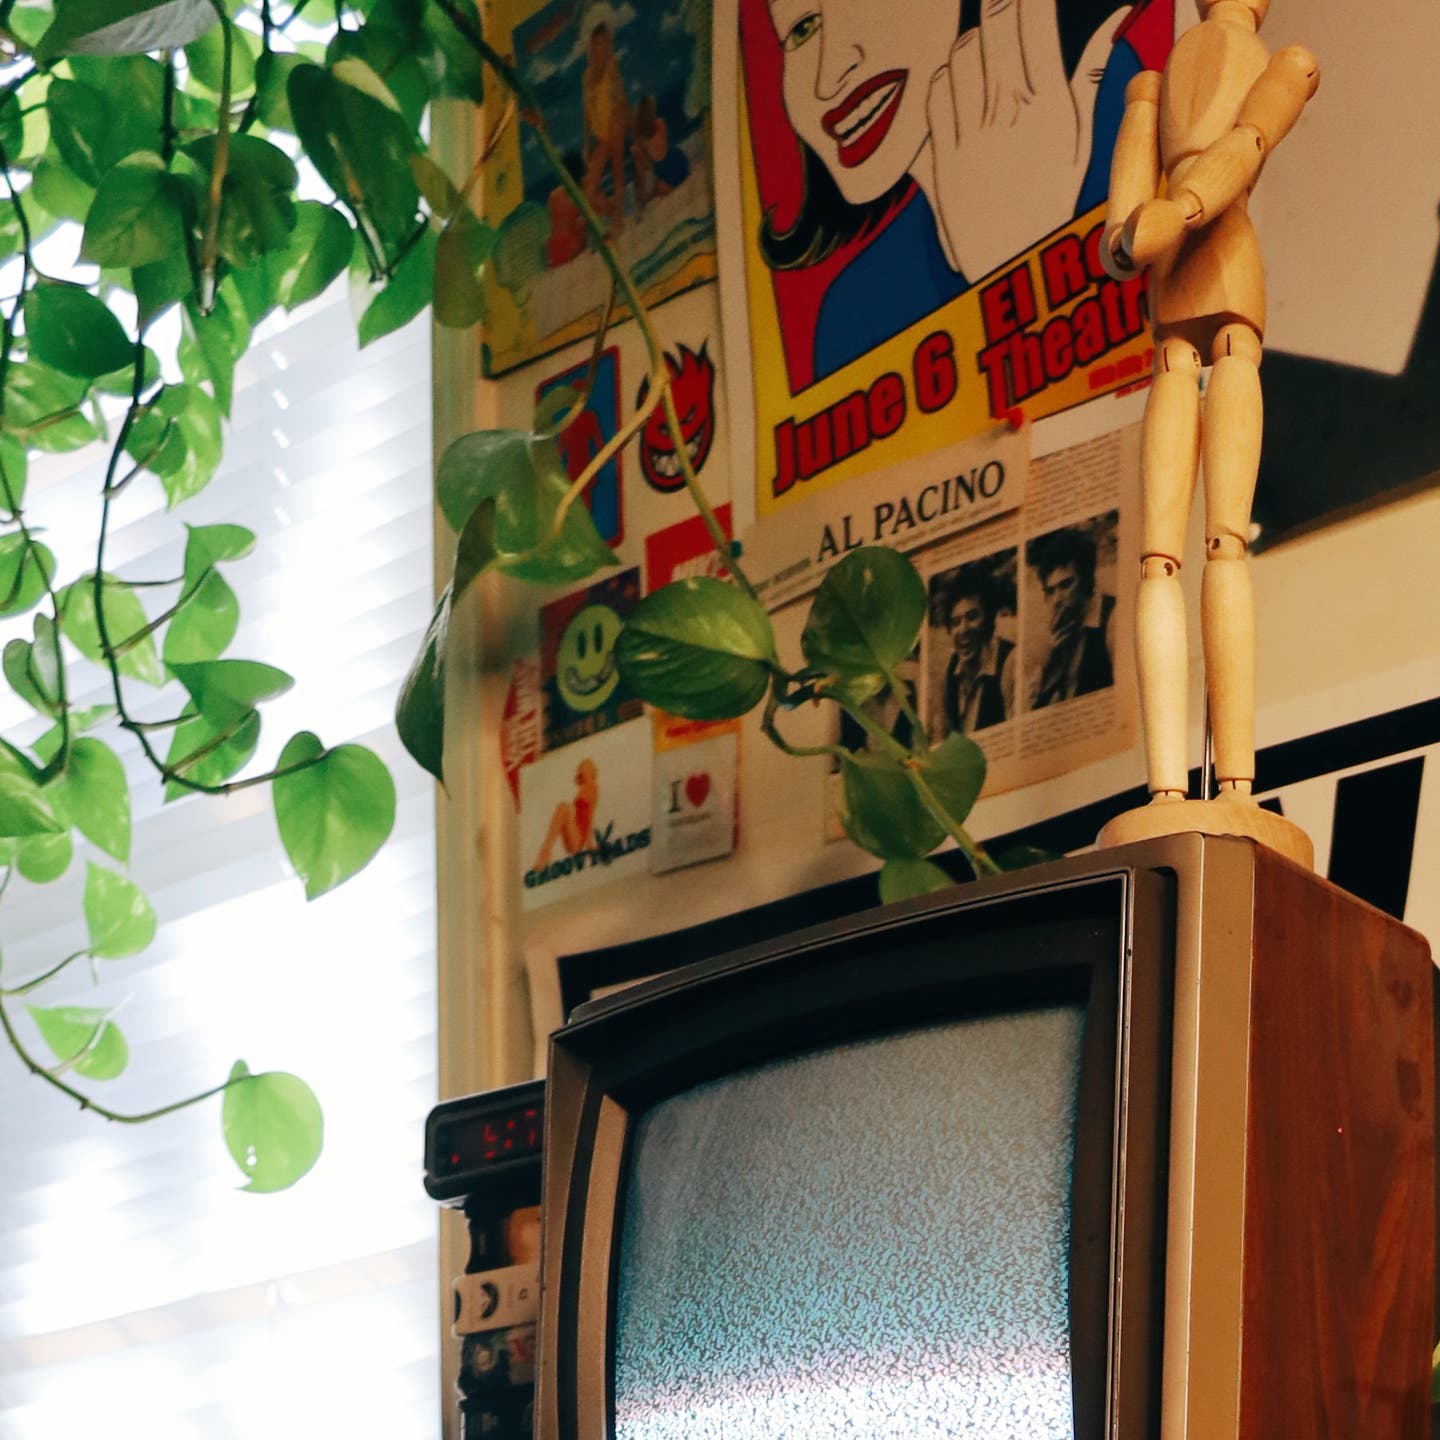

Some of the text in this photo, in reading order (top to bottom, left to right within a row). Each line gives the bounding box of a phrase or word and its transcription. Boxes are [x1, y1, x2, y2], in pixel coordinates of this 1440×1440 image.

[977, 264, 1152, 422] Theatr
[979, 258, 1037, 347] El
[772, 330, 958, 497] June 6
[815, 459, 1006, 564] AL PACINO
